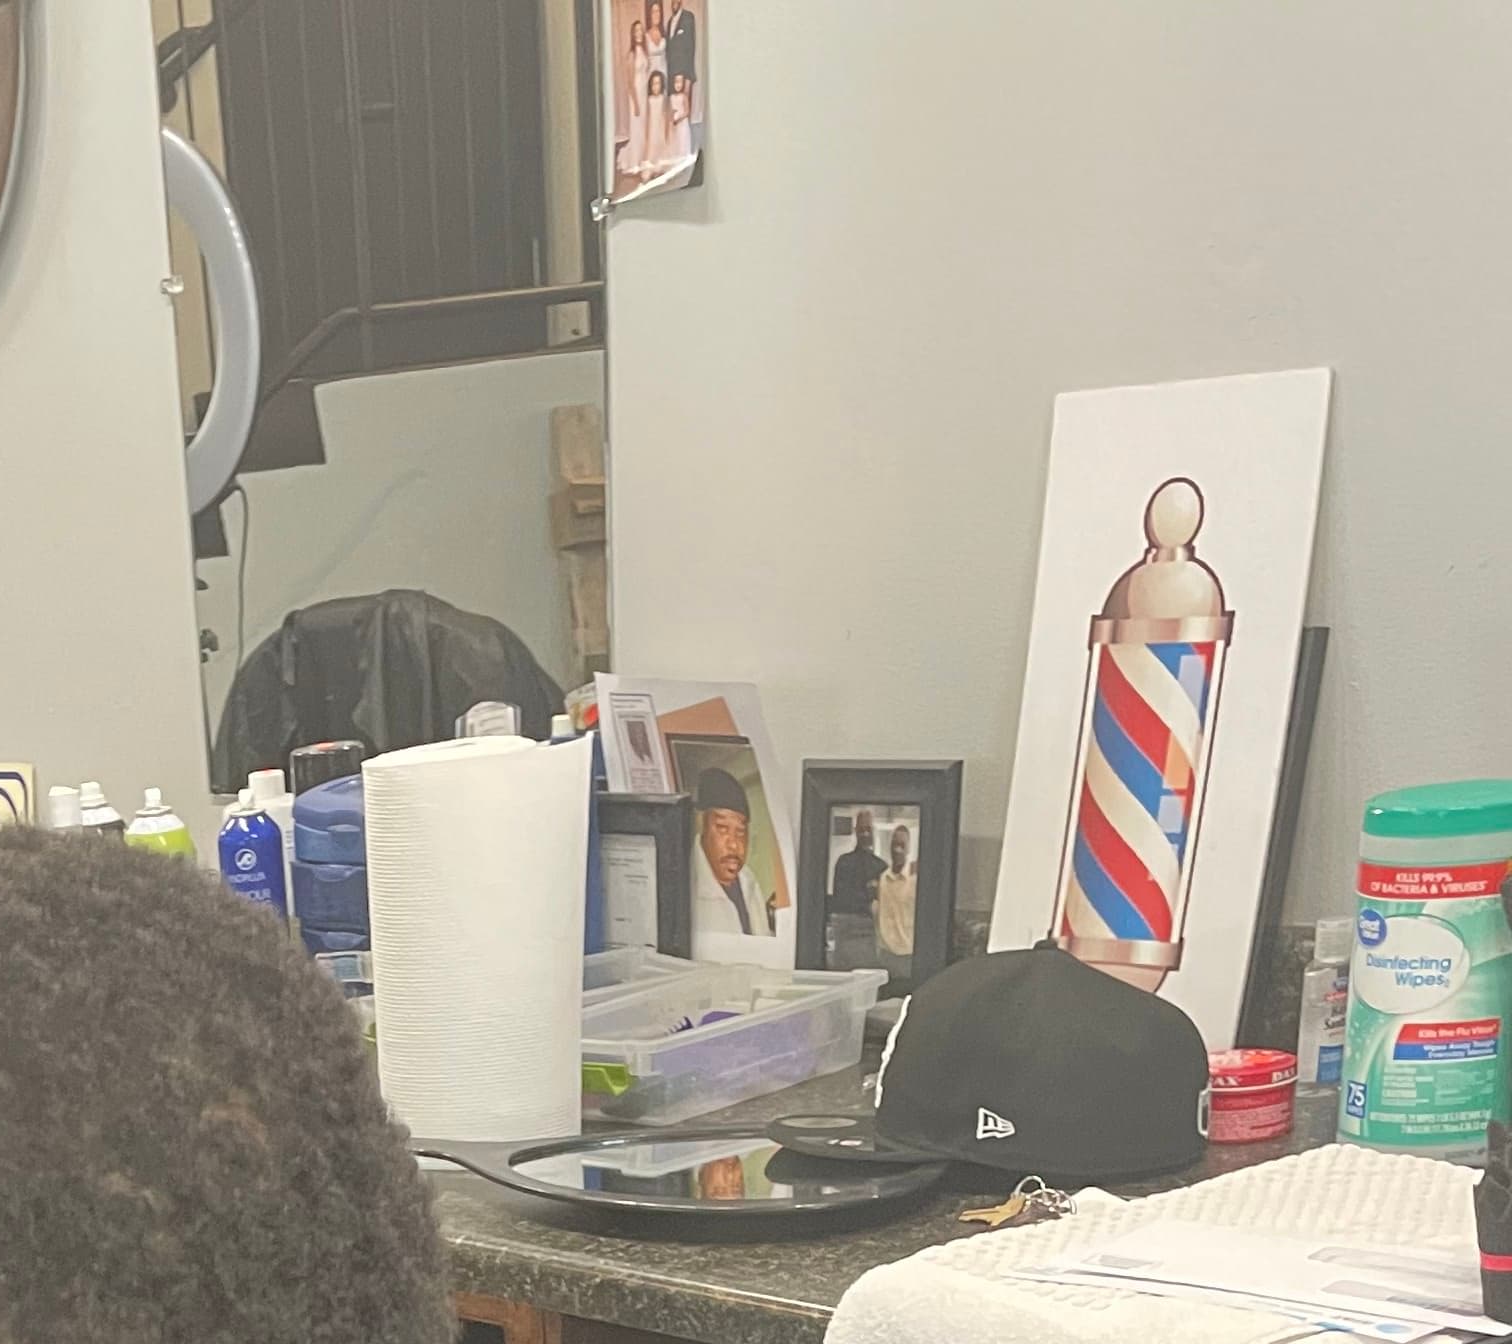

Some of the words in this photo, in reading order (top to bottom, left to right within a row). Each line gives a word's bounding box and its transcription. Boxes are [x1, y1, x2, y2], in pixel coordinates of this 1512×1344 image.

[1395, 872, 1420, 882] KILLS
[1382, 883, 1428, 894] BACTERIA
[1367, 953, 1452, 973] Disinfecting
[1395, 972, 1445, 988] Wipes
[1348, 1082, 1365, 1107] 75
